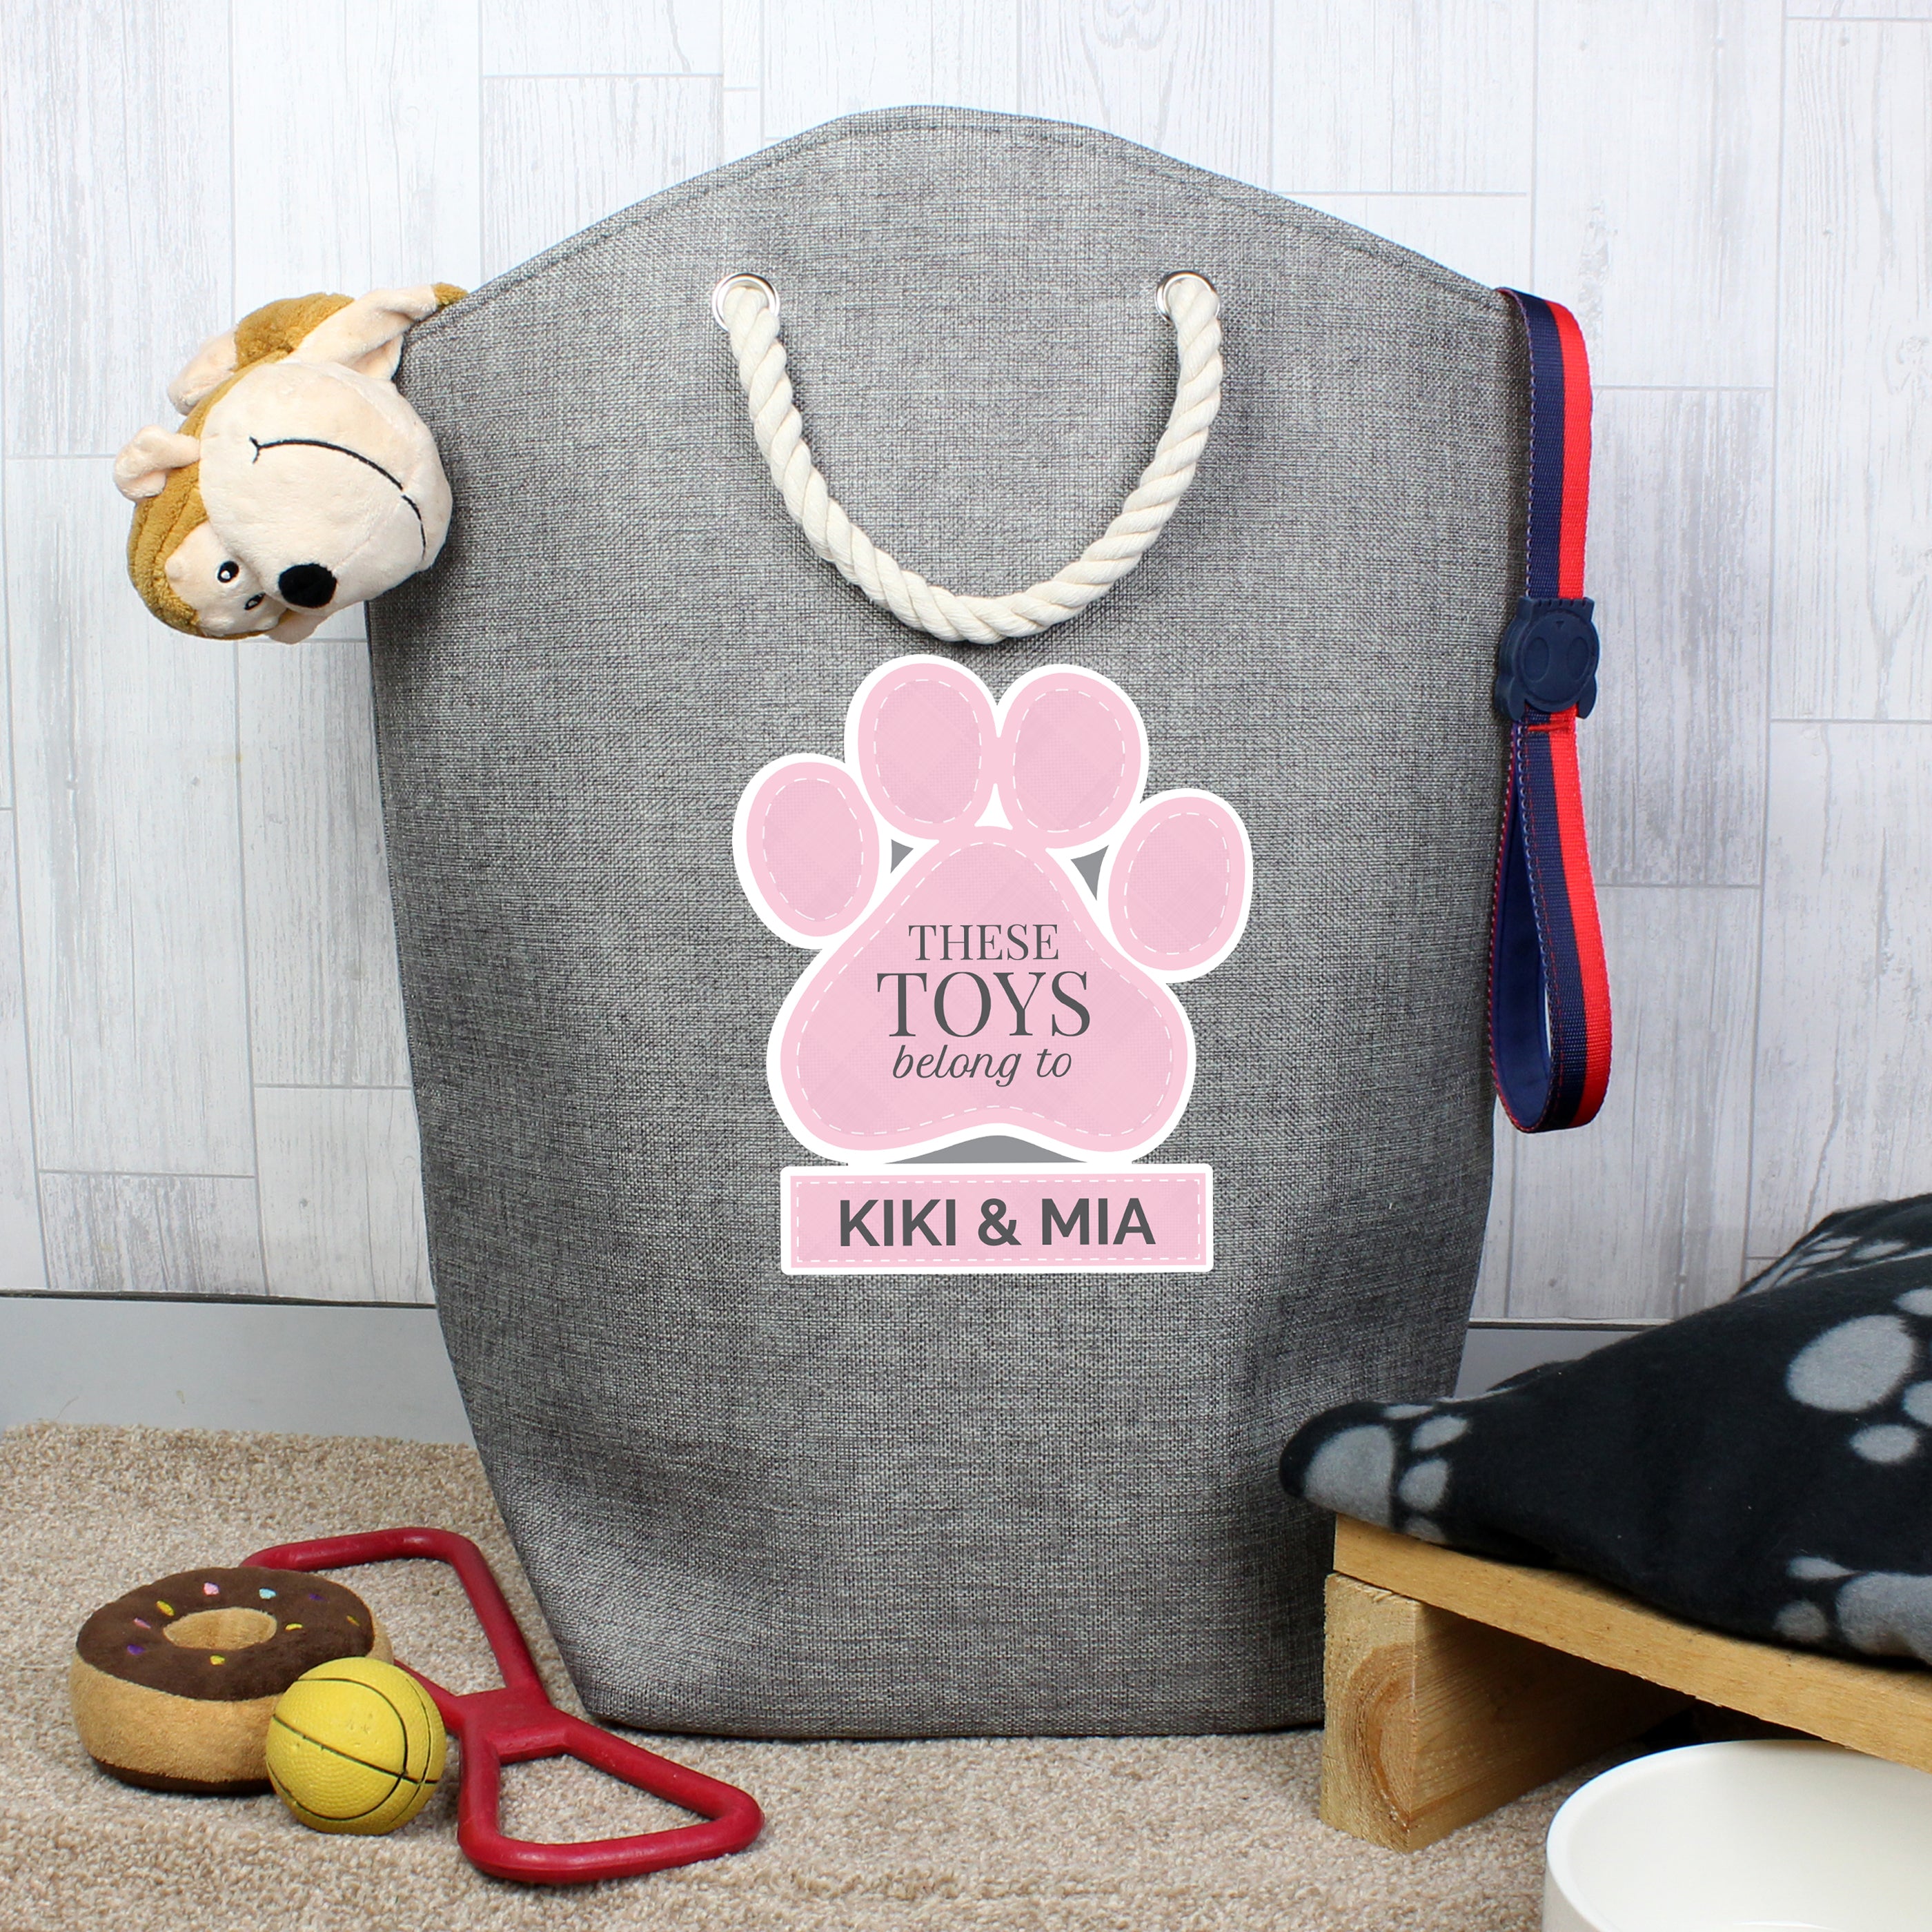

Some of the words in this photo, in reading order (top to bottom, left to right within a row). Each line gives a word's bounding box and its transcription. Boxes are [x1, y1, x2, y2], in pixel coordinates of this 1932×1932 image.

[908, 924, 1059, 960] THESE
[876, 971, 1091, 1038] TOYS
[892, 1044, 1022, 1087] belong
[1036, 1047, 1072, 1078] to
[840, 1199, 956, 1247] KIKI
[978, 1198, 1022, 1247] &
[1041, 1197, 1156, 1245] MIA
